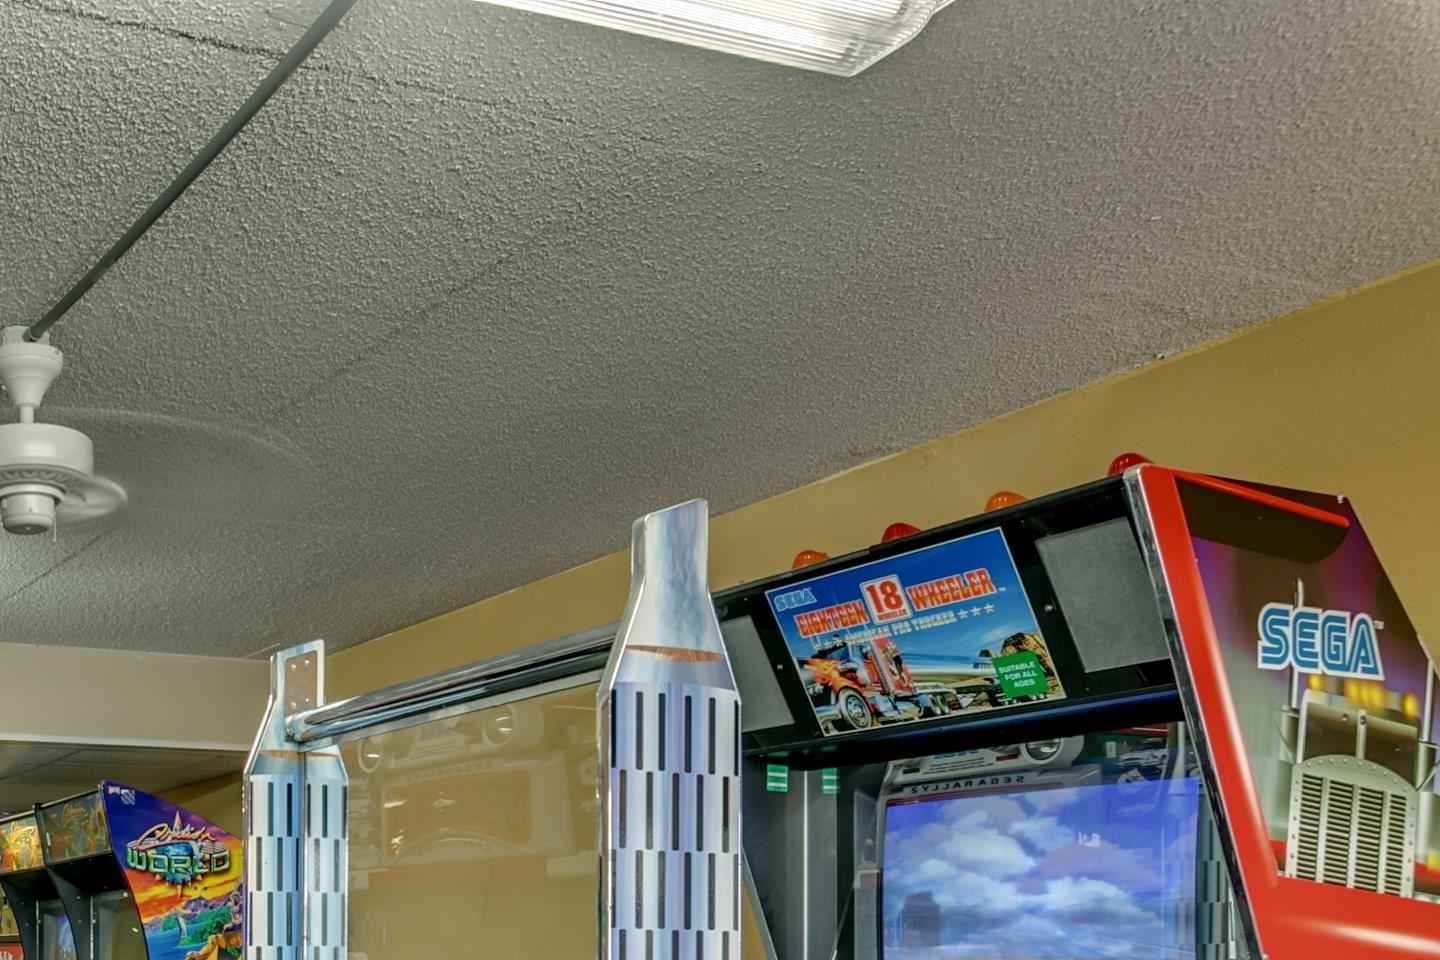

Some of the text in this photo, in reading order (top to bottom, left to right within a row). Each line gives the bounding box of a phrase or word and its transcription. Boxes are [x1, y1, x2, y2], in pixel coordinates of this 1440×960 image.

[774, 589, 817, 612] SEGA
[794, 599, 870, 638] EIGHTEEN
[865, 580, 904, 613] 18
[905, 568, 997, 612] WHEELER
[913, 611, 957, 630] TRUCKER
[1257, 602, 1385, 681] SEGA
[998, 661, 1036, 674] SUITABLE
[1005, 670, 1038, 680] FOR ALL
[1014, 679, 1035, 688] AGES
[126, 847, 230, 873] WORLD
